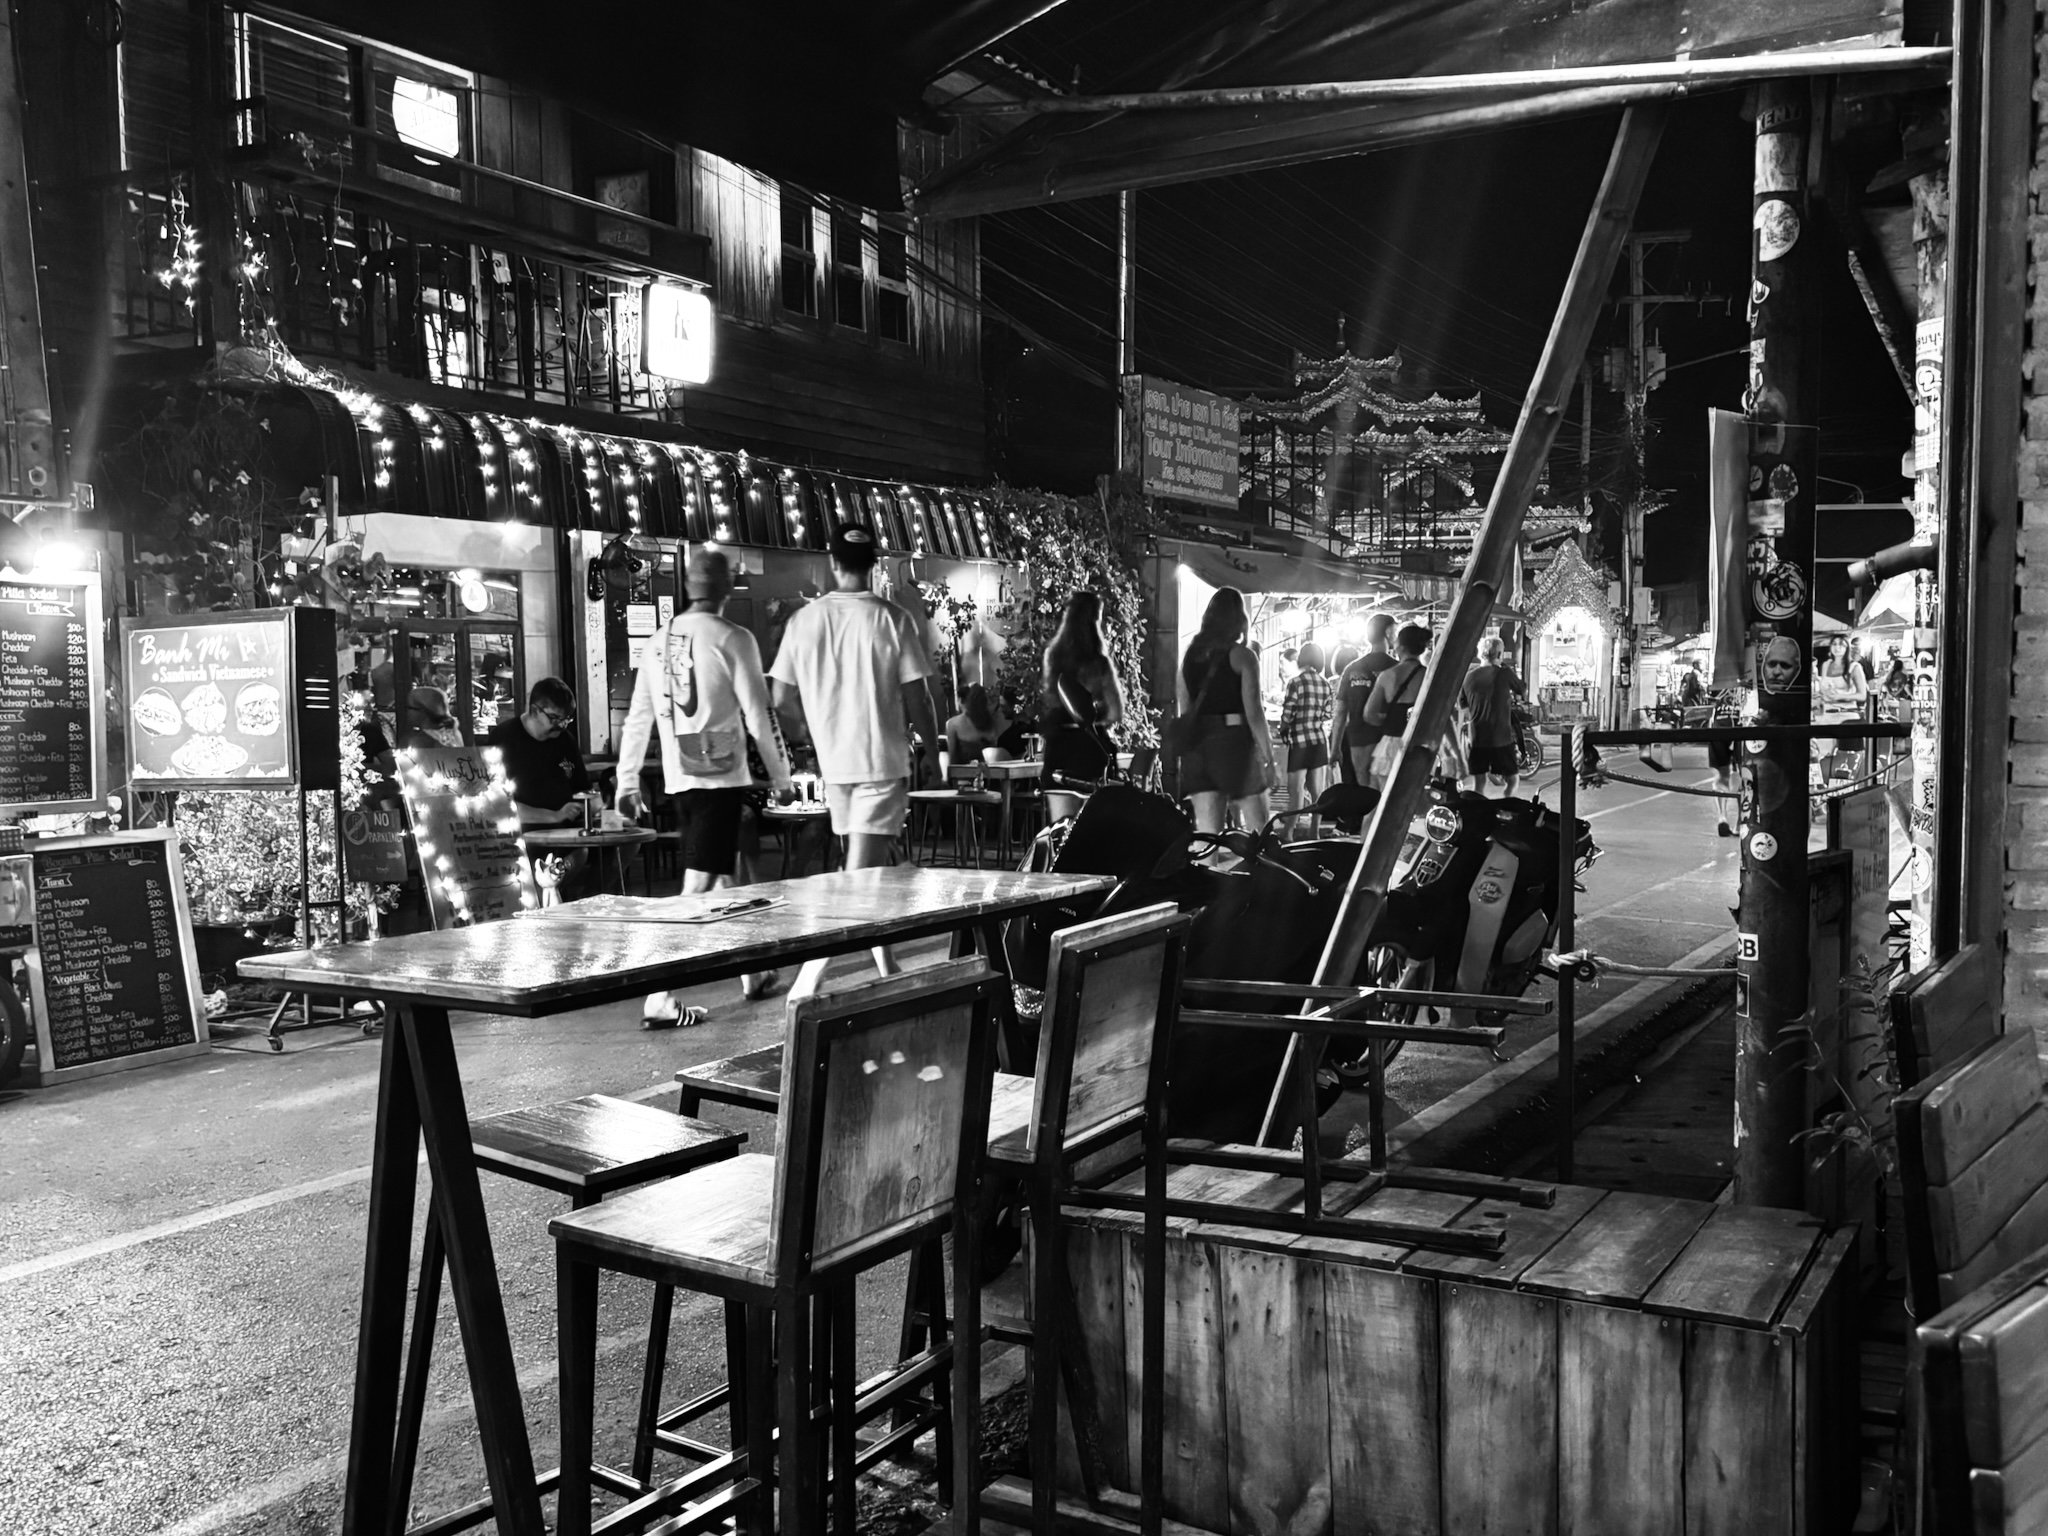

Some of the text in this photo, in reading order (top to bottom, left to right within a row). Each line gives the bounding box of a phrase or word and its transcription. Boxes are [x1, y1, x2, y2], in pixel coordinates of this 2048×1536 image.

[1145, 430, 1238, 474] Tour Information
[2, 630, 36, 642] Mushroom
[1, 642, 31, 652] Cheddar
[139, 631, 230, 665] Banh Mi
[1, 653, 17, 664] Feta
[33, 665, 48, 676] Feta
[160, 663, 268, 683] Sandwich Vietnamese
[374, 812, 390, 827] NO
[109, 847, 135, 861] Salad
[44, 878, 65, 888] Tuna
[54, 898, 90, 909] Mushroom
[55, 909, 85, 919] Cheddar
[58, 919, 74, 929] Feta
[93, 926, 107, 935] Feta
[61, 939, 97, 950] Mushroom
[63, 949, 100, 959] Mushroom
[133, 941, 147, 950] Feta
[65, 960, 100, 970] Mushroom
[52, 972, 90, 985] Vegetable
